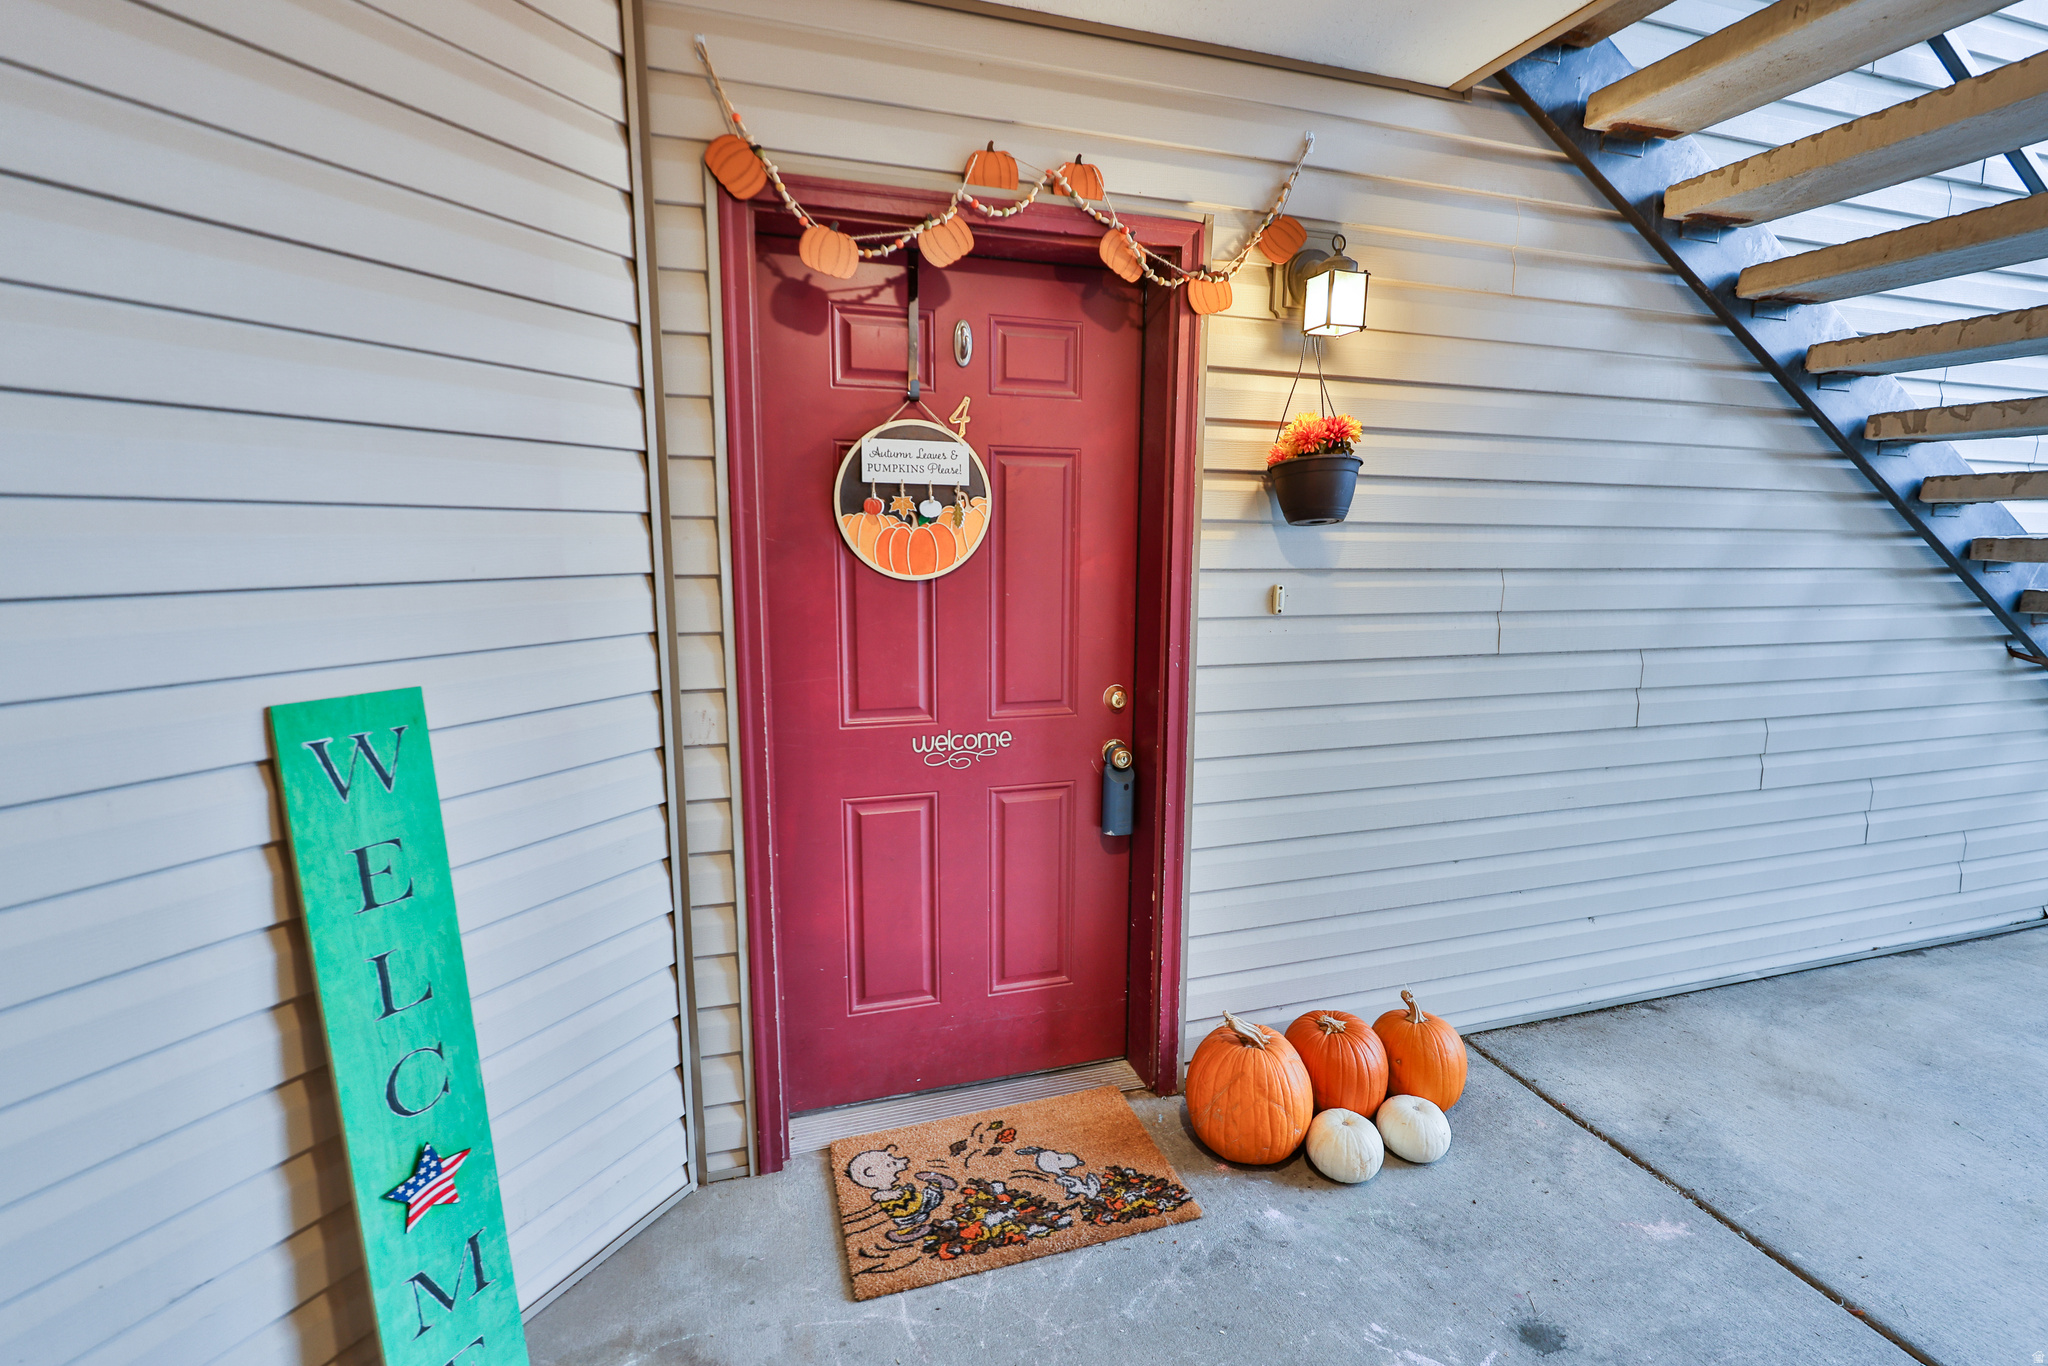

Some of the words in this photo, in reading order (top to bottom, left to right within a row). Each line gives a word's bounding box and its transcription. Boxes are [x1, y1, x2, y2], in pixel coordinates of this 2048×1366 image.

[949, 396, 971, 438] 4
[869, 446, 913, 459] Autumn
[916, 447, 947, 460] Leaves
[951, 449, 958, 460] &
[867, 462, 925, 474] PUMPKINS
[927, 462, 962, 475] Please!
[912, 730, 1012, 753] welcome
[301, 724, 497, 1366] WELCM
